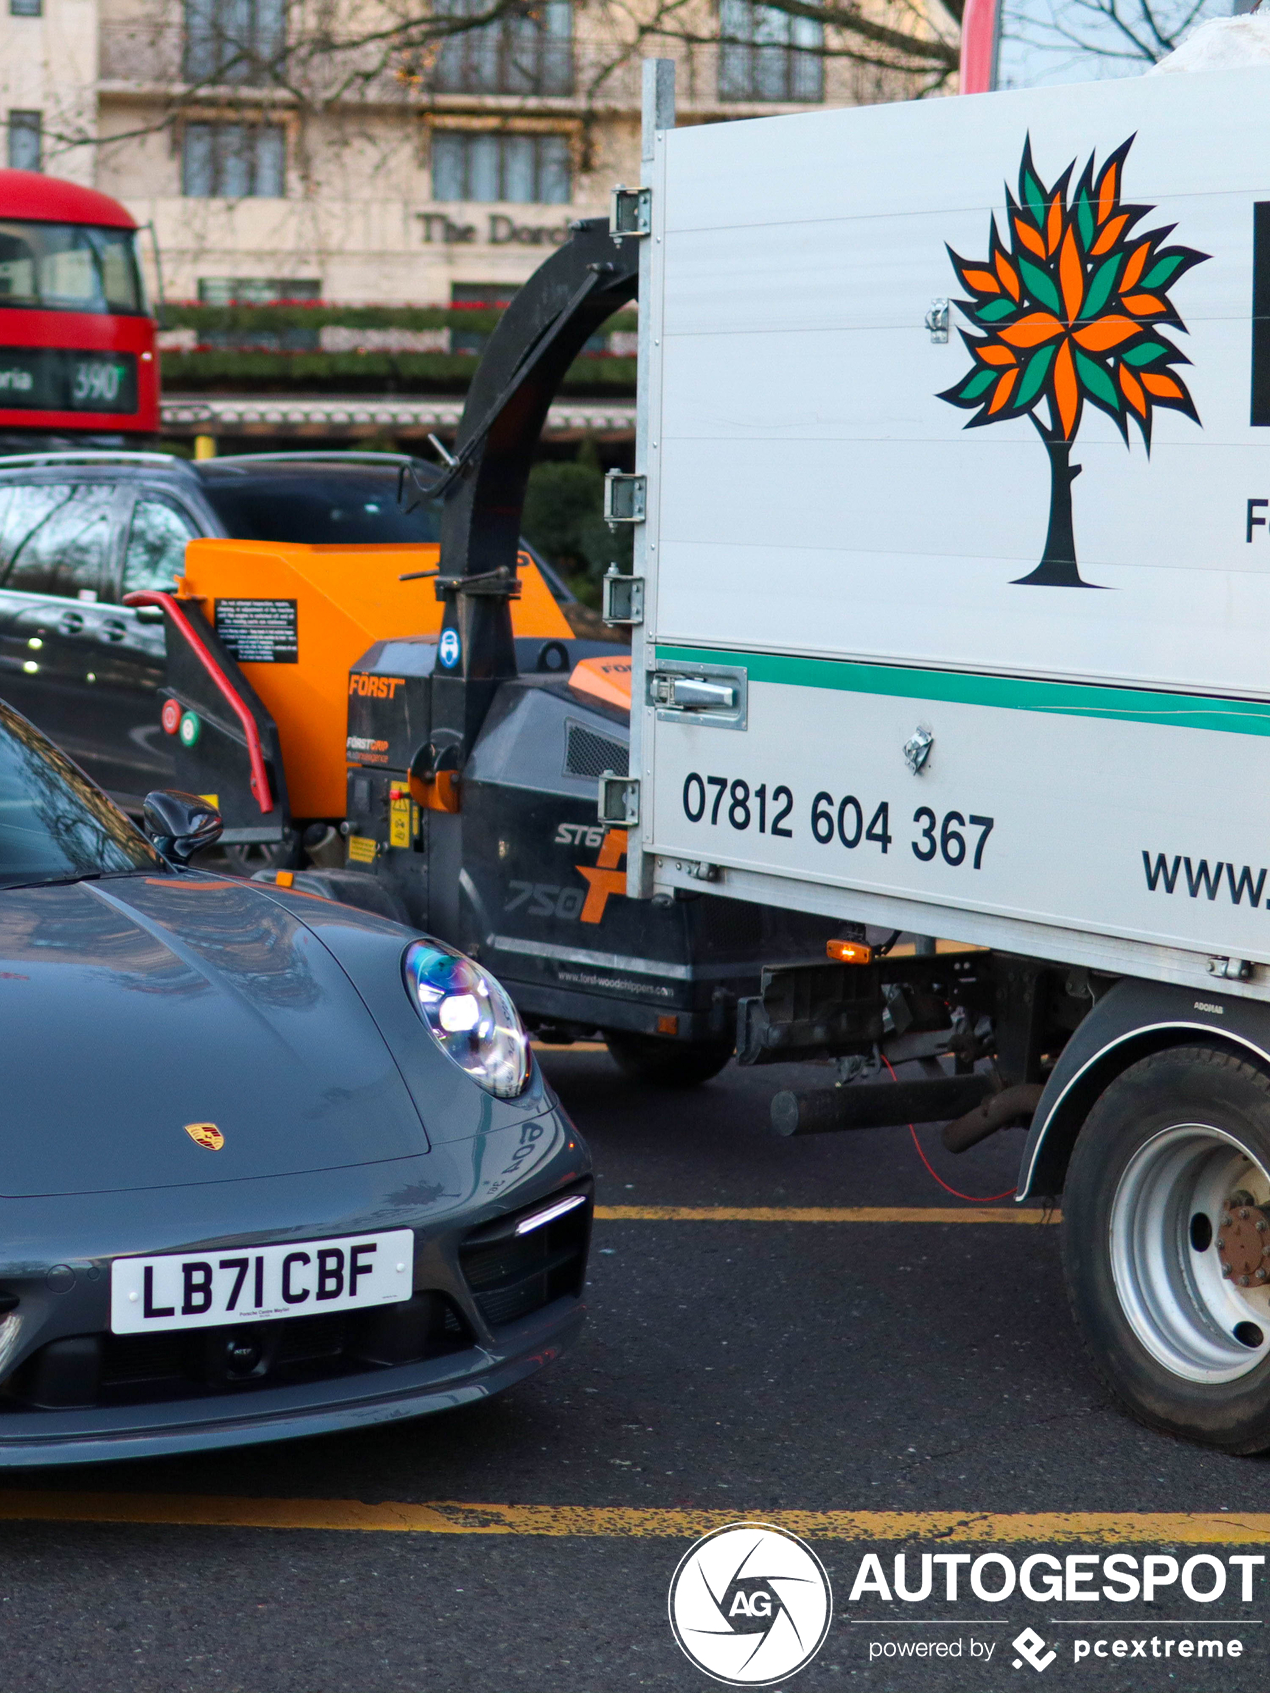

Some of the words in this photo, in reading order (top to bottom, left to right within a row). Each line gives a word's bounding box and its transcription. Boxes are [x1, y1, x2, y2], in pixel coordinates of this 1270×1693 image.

[416, 213, 475, 244] The
[488, 213, 572, 246] Dorc
[74, 362, 119, 400] 390
[349, 672, 405, 699] FÖRST
[683, 772, 793, 838] 07812
[811, 791, 892, 854] 604
[911, 806, 994, 870] 367
[504, 880, 585, 920] 750
[143, 1256, 264, 1319] LB71
[282, 1242, 378, 1304] CBF
